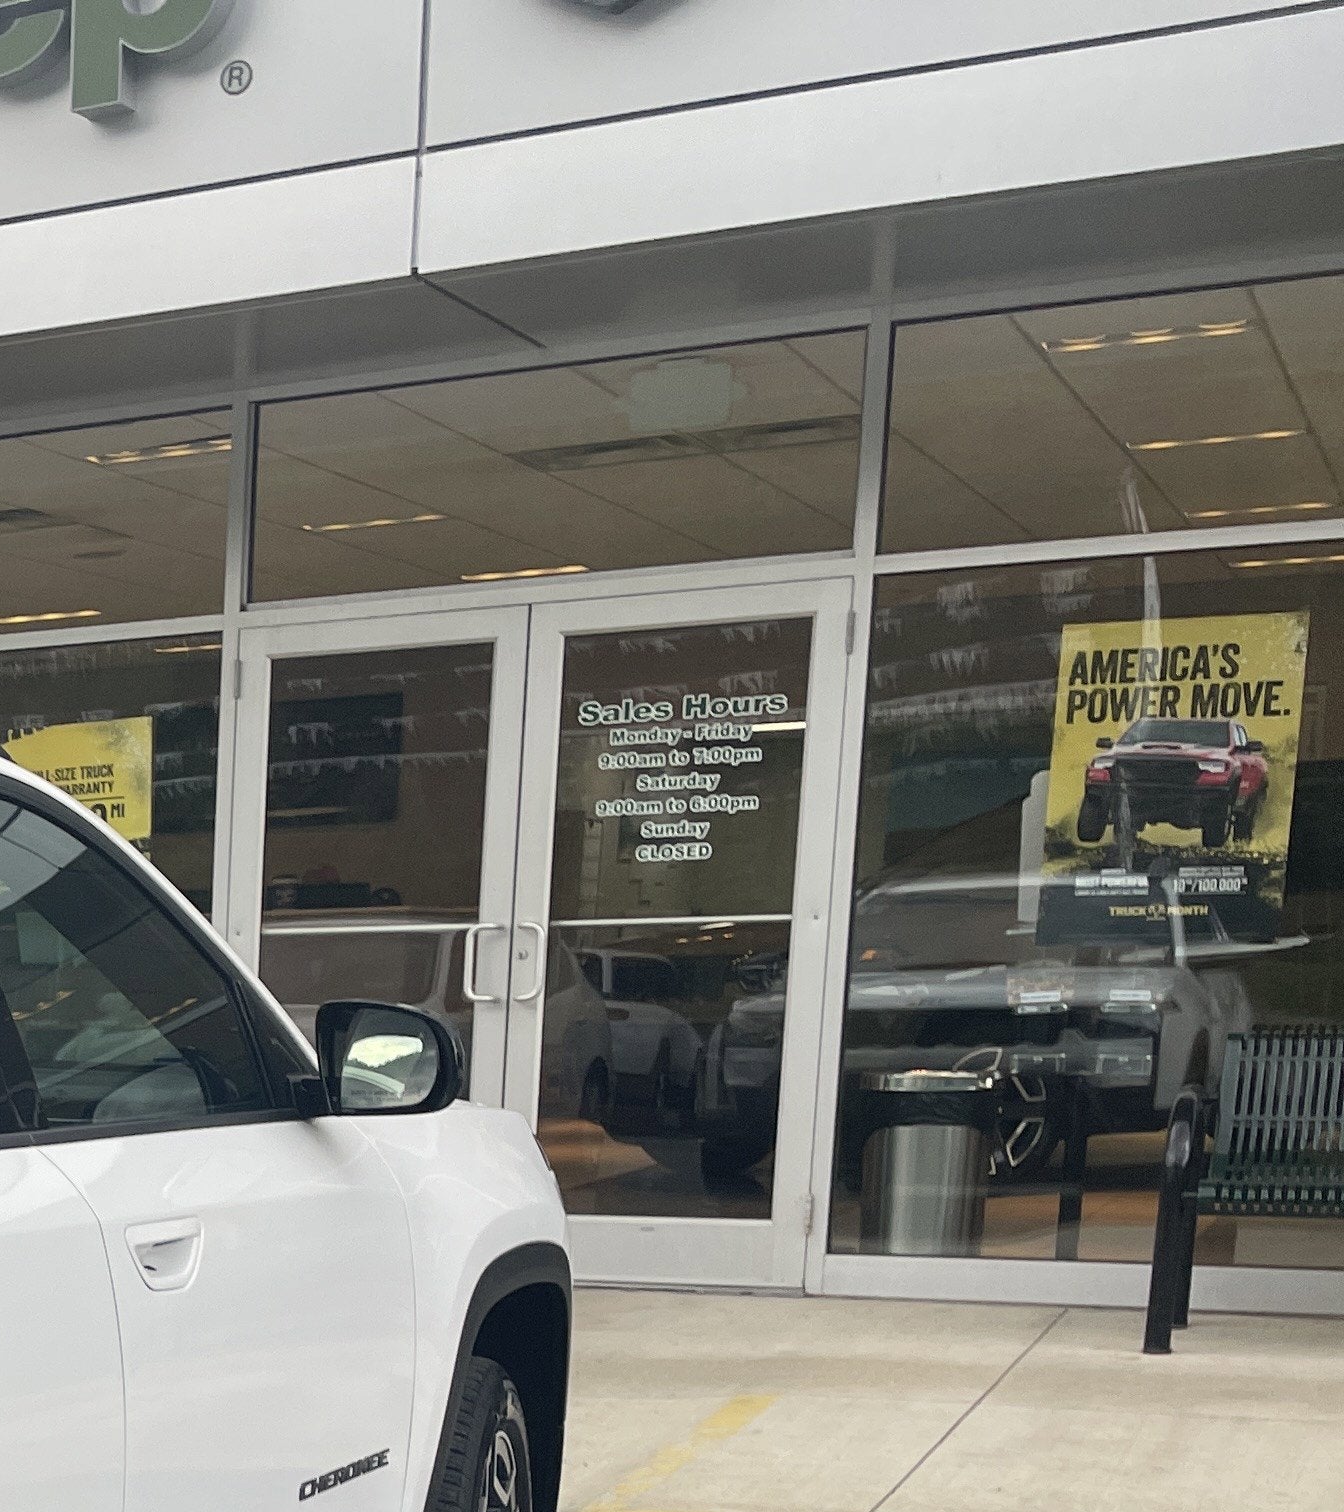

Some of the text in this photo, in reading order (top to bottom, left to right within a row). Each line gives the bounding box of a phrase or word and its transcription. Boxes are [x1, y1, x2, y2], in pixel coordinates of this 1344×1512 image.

[1068, 643, 1240, 686] AMERICA'S
[578, 693, 788, 726] Sales Hours
[1066, 680, 1292, 724] POWER MOVE.
[609, 726, 683, 747] Monday
[694, 722, 755, 742] Friday
[597, 751, 667, 770] 9:00am
[669, 748, 690, 766] to
[80, 763, 115, 779] TRUCK
[636, 772, 721, 792] Saturday
[595, 798, 663, 817] 9:00am
[665, 797, 688, 813] to
[640, 819, 710, 839] Sunday
[635, 841, 713, 862] CLOSED
[298, 1447, 390, 1502] CHEROKEE
